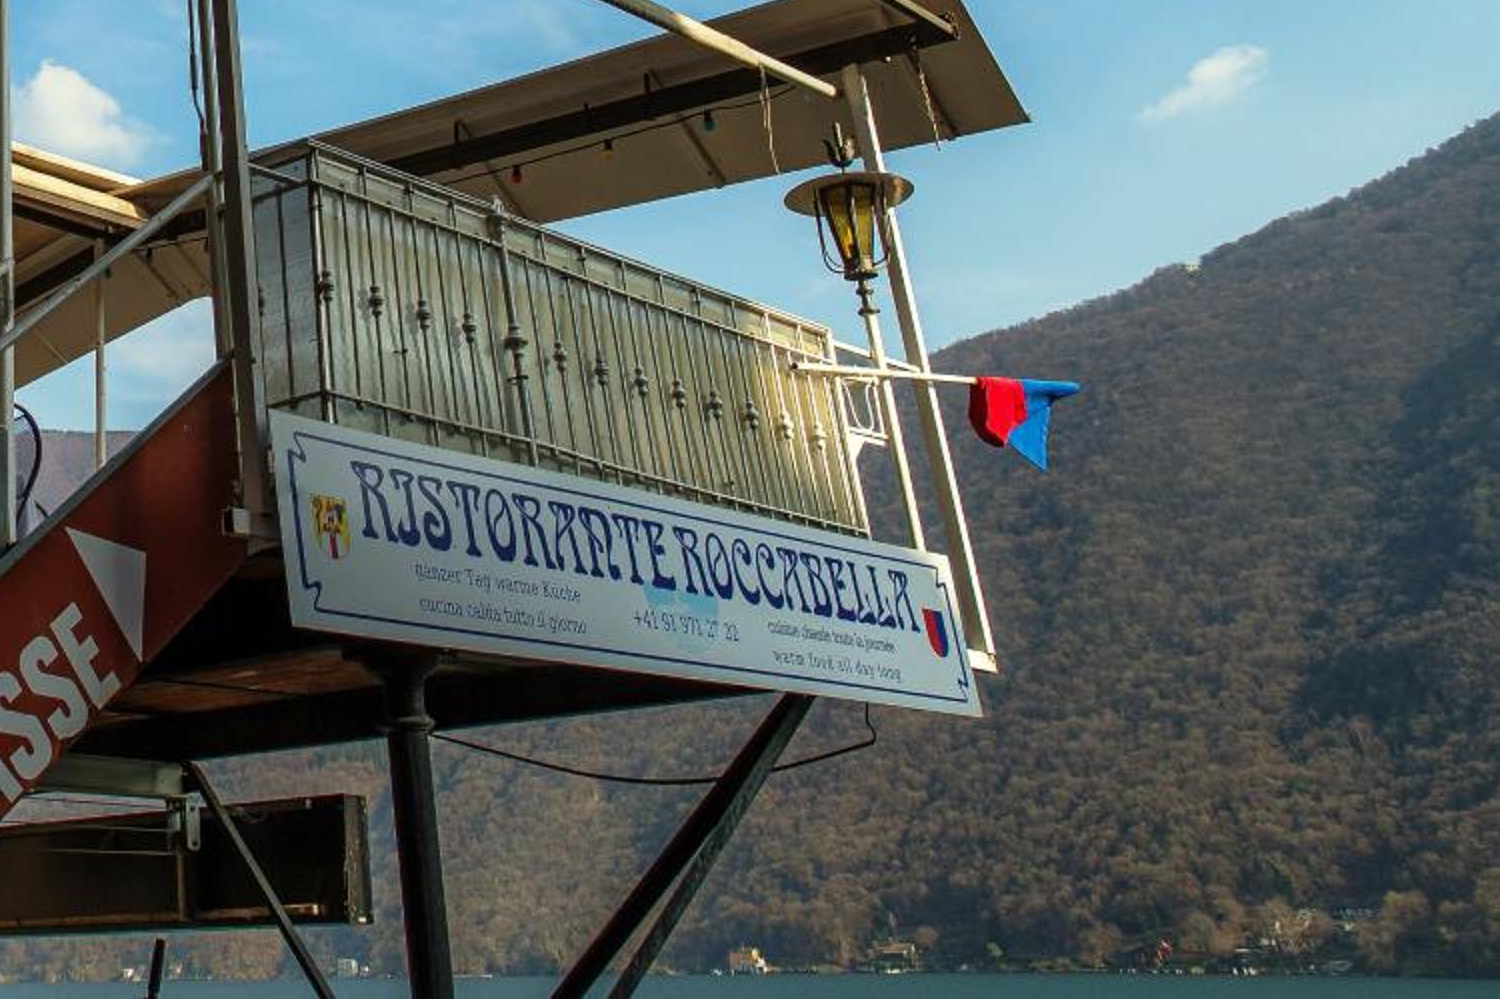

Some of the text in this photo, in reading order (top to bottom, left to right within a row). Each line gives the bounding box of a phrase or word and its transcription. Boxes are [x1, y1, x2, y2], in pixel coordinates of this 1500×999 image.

[350, 460, 921, 633] RISTORANTE ROCCABELLA
[633, 609, 659, 630] +41
